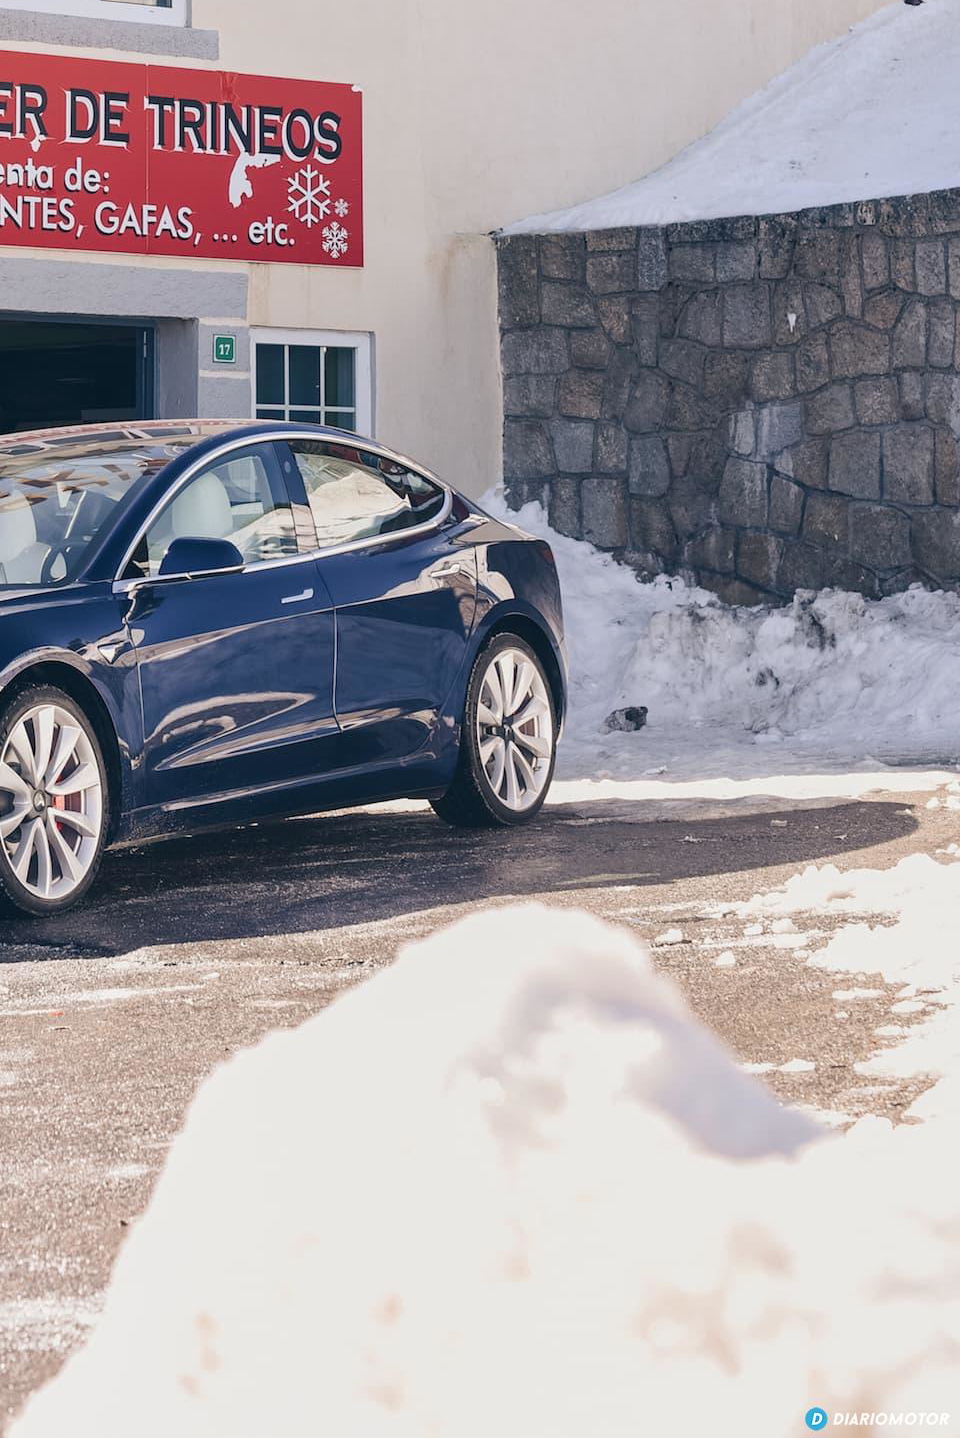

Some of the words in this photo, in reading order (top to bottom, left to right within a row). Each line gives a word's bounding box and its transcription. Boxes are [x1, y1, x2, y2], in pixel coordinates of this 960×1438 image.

[65, 88, 130, 149] DE
[145, 93, 342, 164] TRINEOS
[64, 156, 111, 193] de:
[94, 200, 202, 246] GAFAS,
[247, 215, 297, 247] etc.
[219, 344, 230, 355] 17
